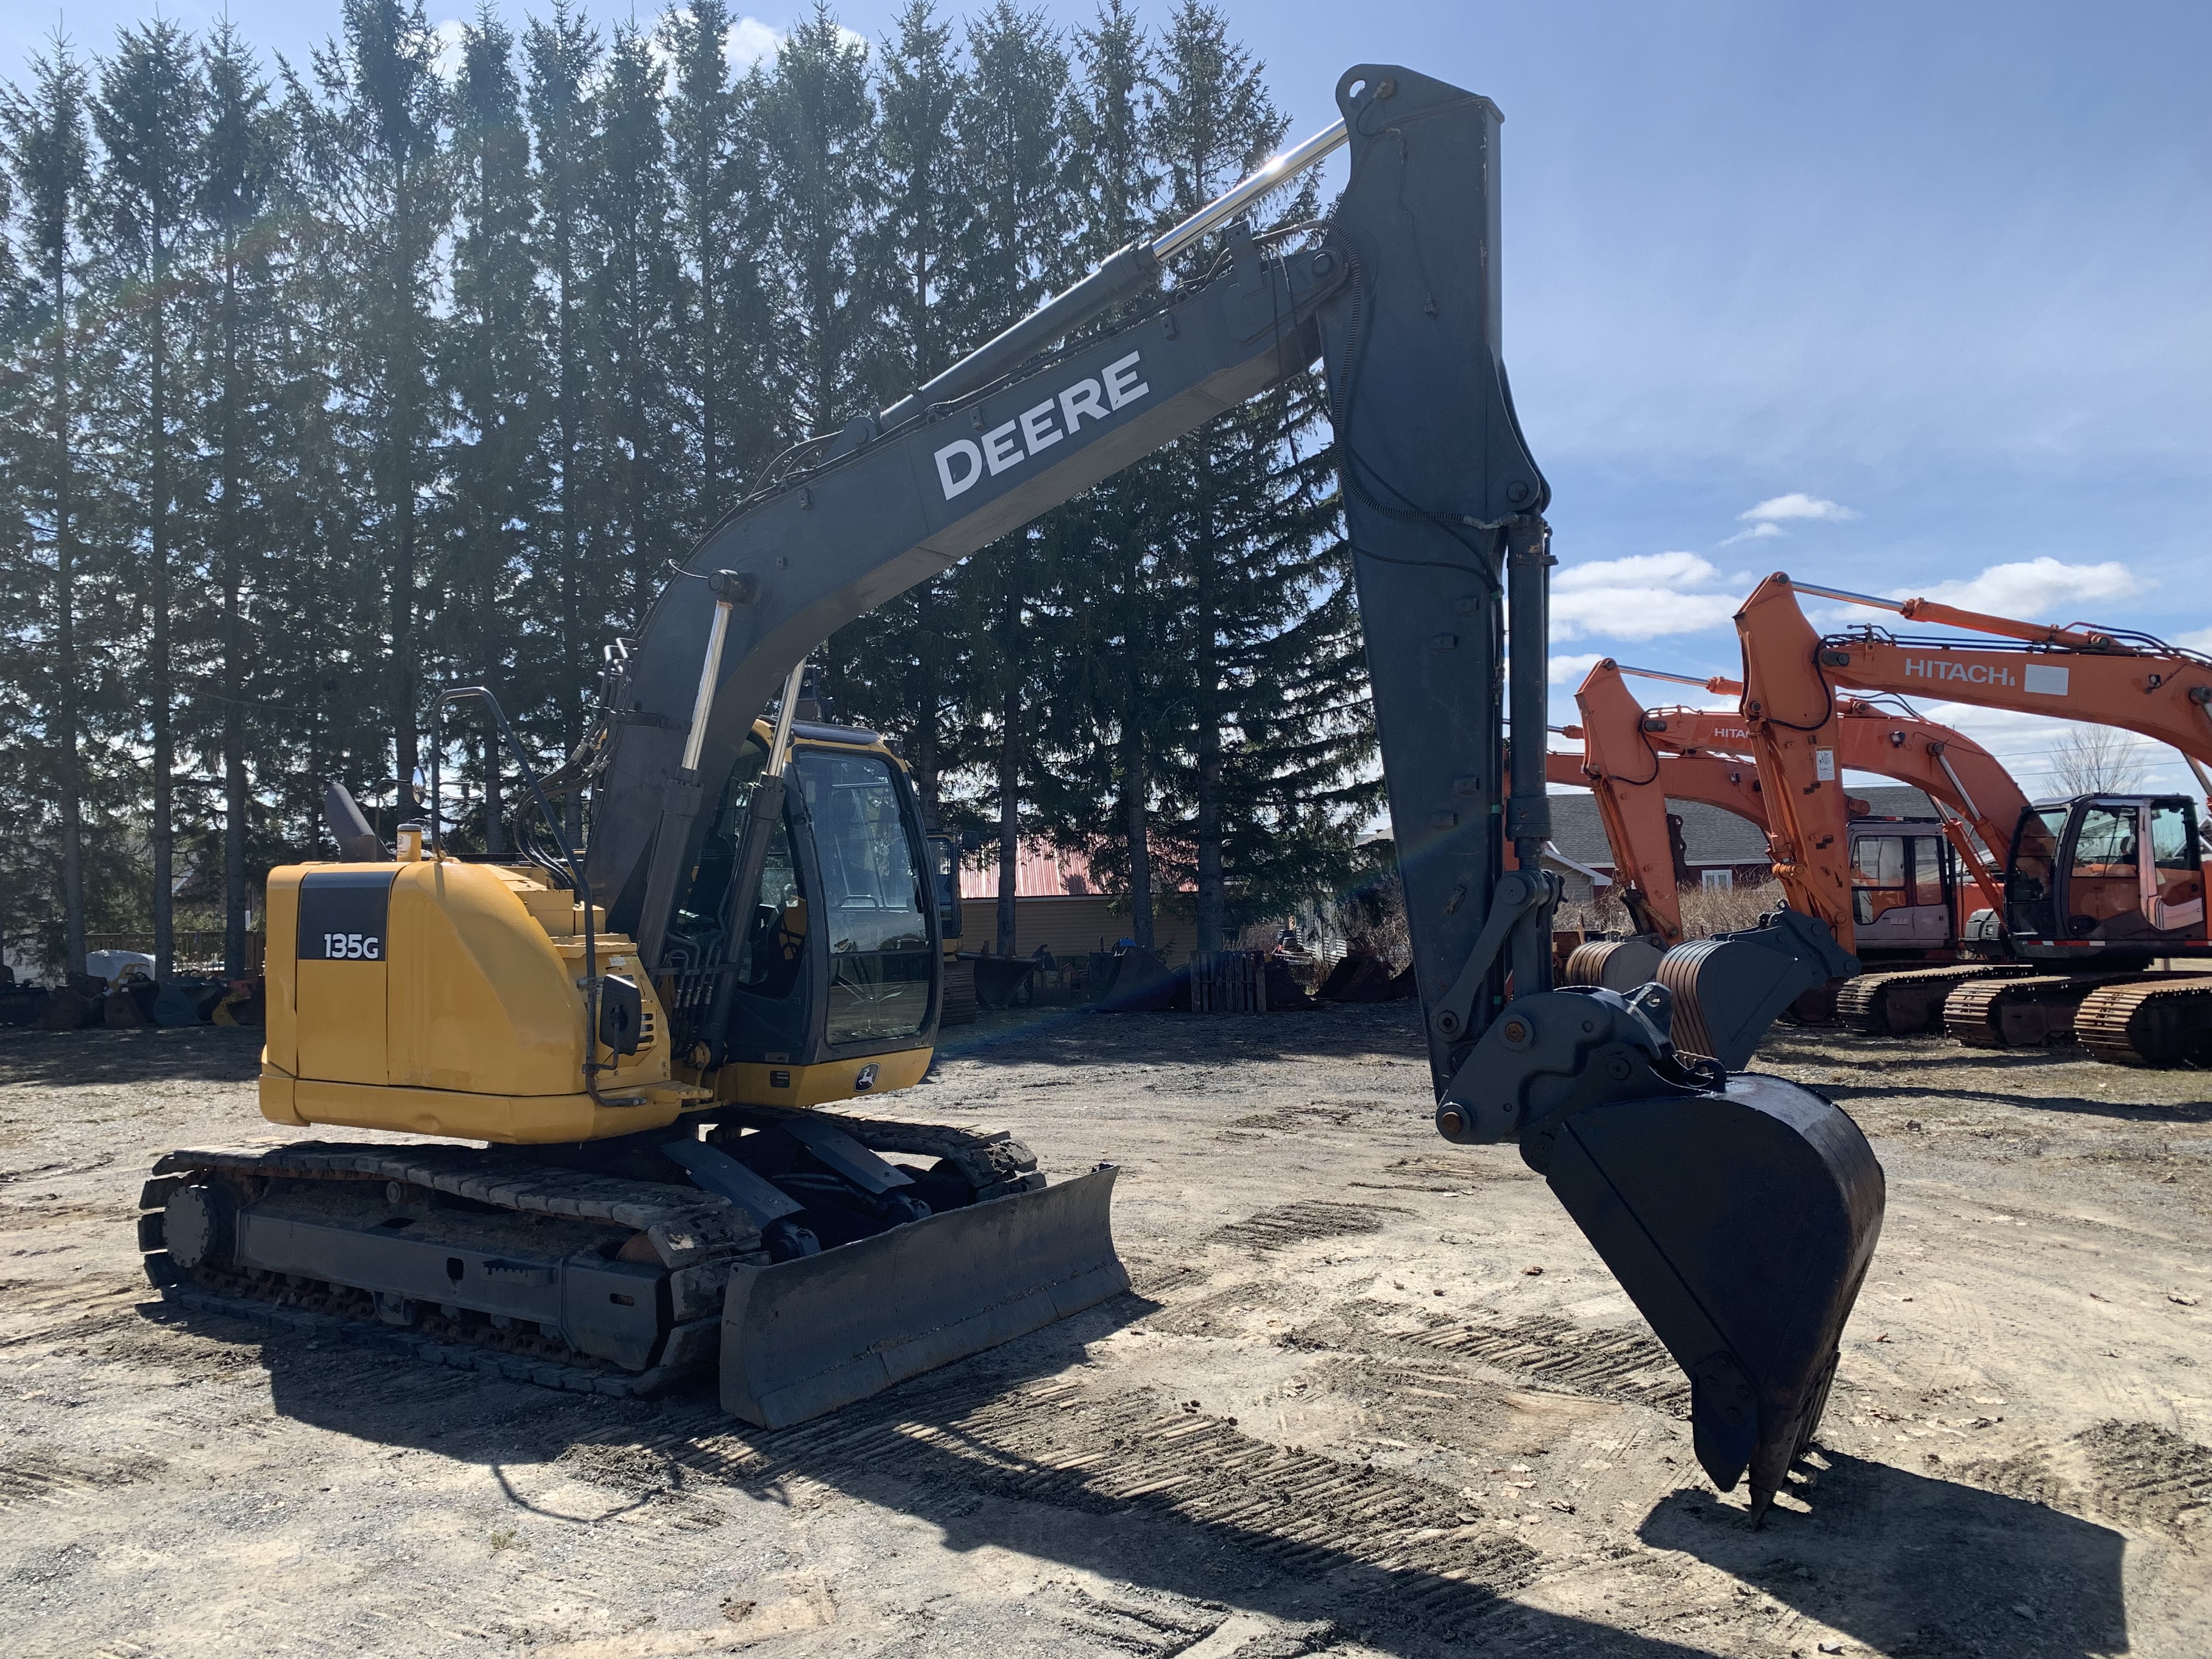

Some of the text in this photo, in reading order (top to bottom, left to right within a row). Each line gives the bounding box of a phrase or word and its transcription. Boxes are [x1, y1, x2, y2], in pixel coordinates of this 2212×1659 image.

[934, 349, 1149, 501] DEERE
[1714, 727, 1750, 738] HITA
[324, 933, 379, 959] 135G
